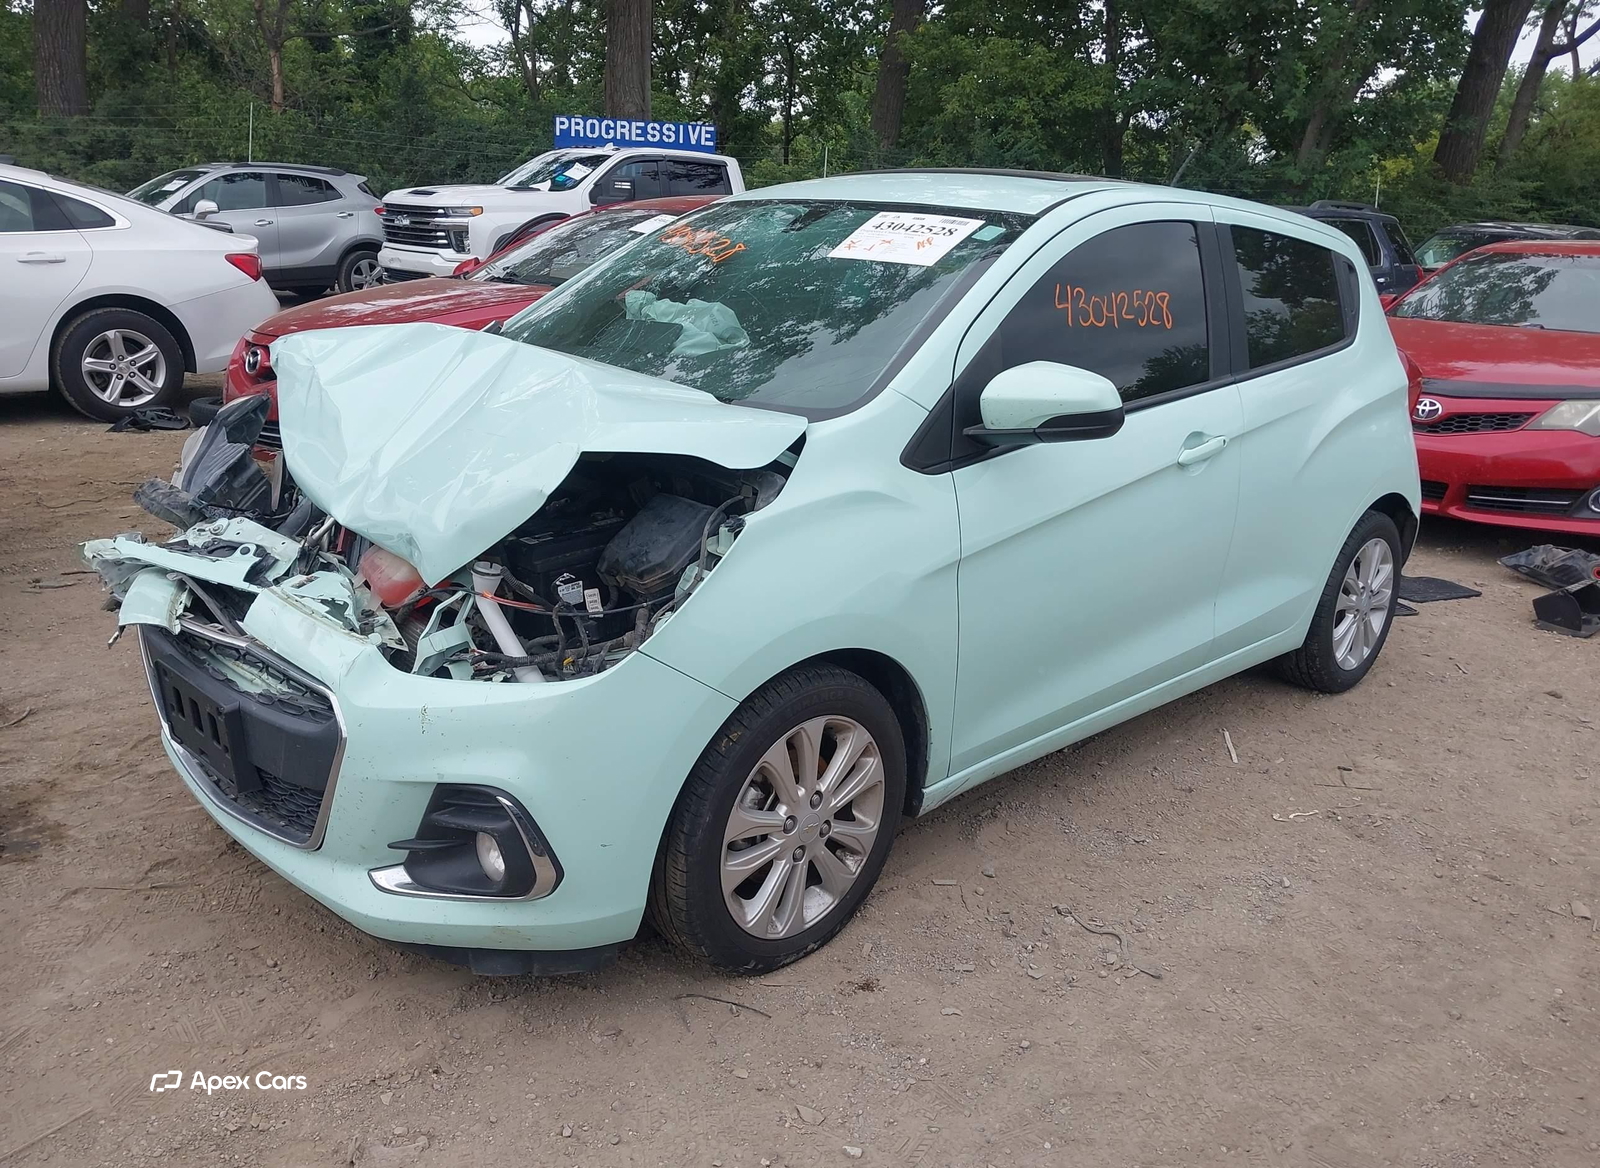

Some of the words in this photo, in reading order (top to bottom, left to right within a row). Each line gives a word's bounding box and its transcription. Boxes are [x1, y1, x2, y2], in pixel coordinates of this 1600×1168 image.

[555, 116, 715, 146] PROGRESSIVE
[872, 221, 958, 237] 43042528
[1055, 283, 1173, 330] 43042528
